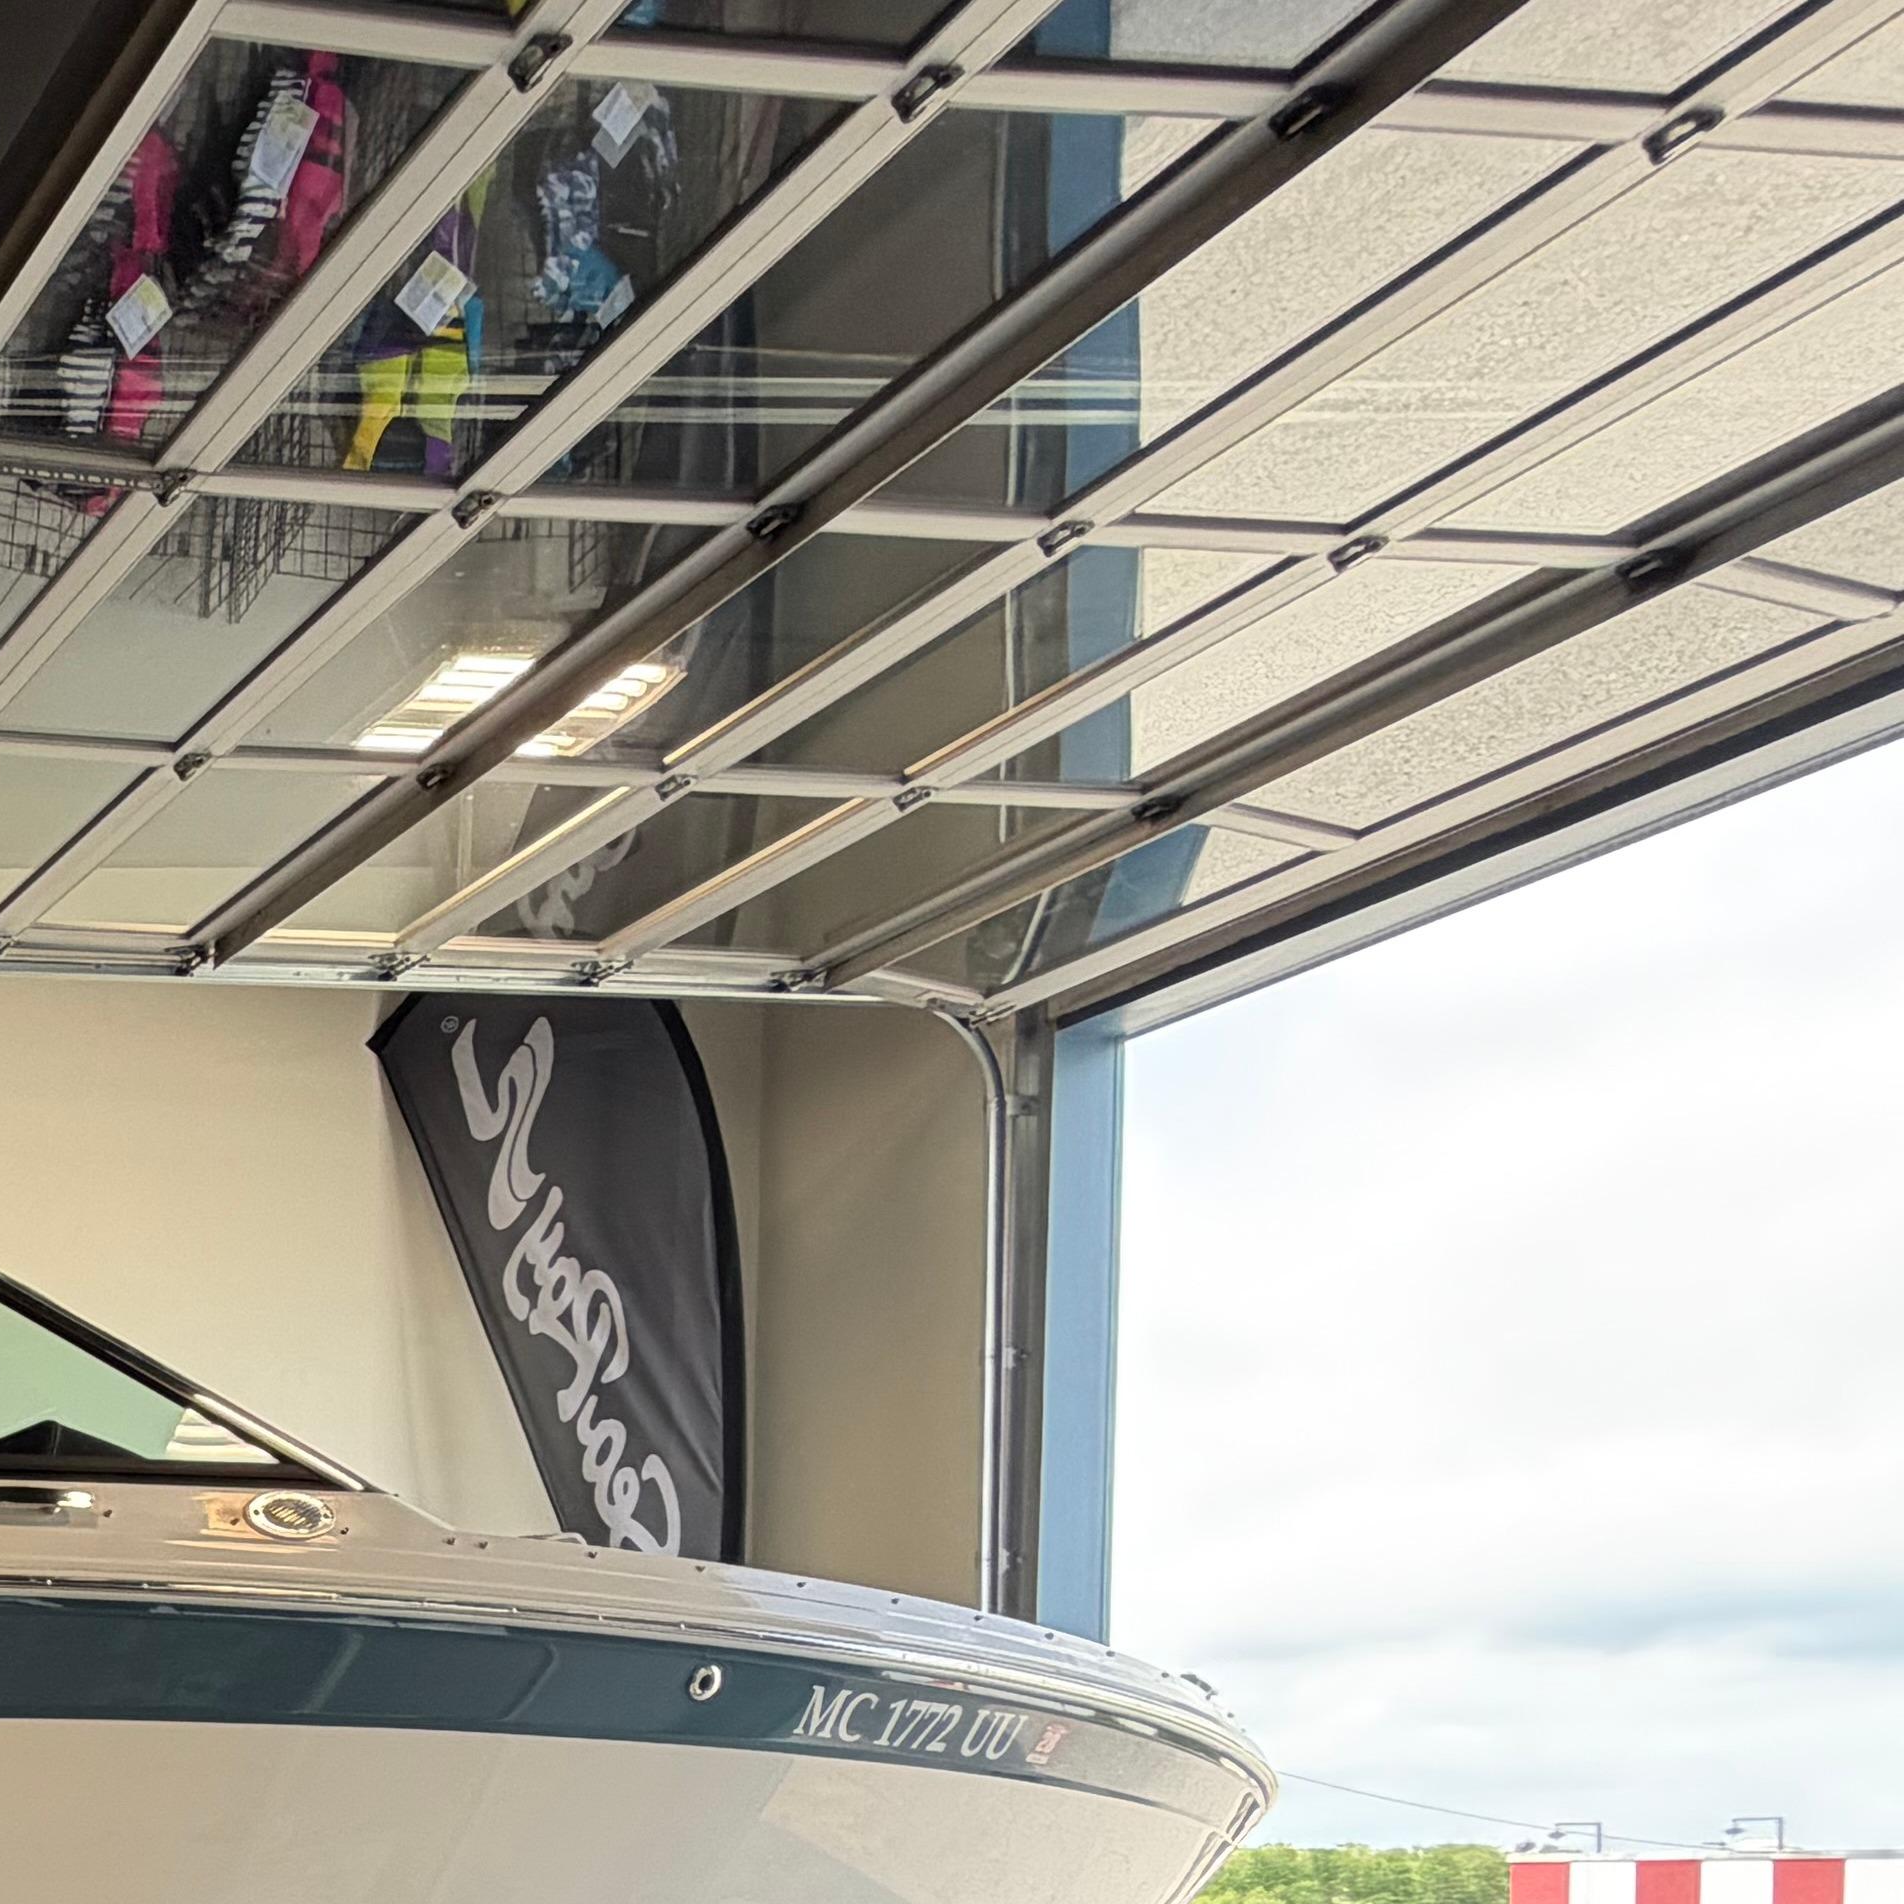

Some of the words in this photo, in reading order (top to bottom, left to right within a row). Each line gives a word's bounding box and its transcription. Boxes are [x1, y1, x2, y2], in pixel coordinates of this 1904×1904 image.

[793, 1685, 879, 1742] MC
[873, 1699, 963, 1752] 1772
[960, 1709, 1029, 1760] UU
